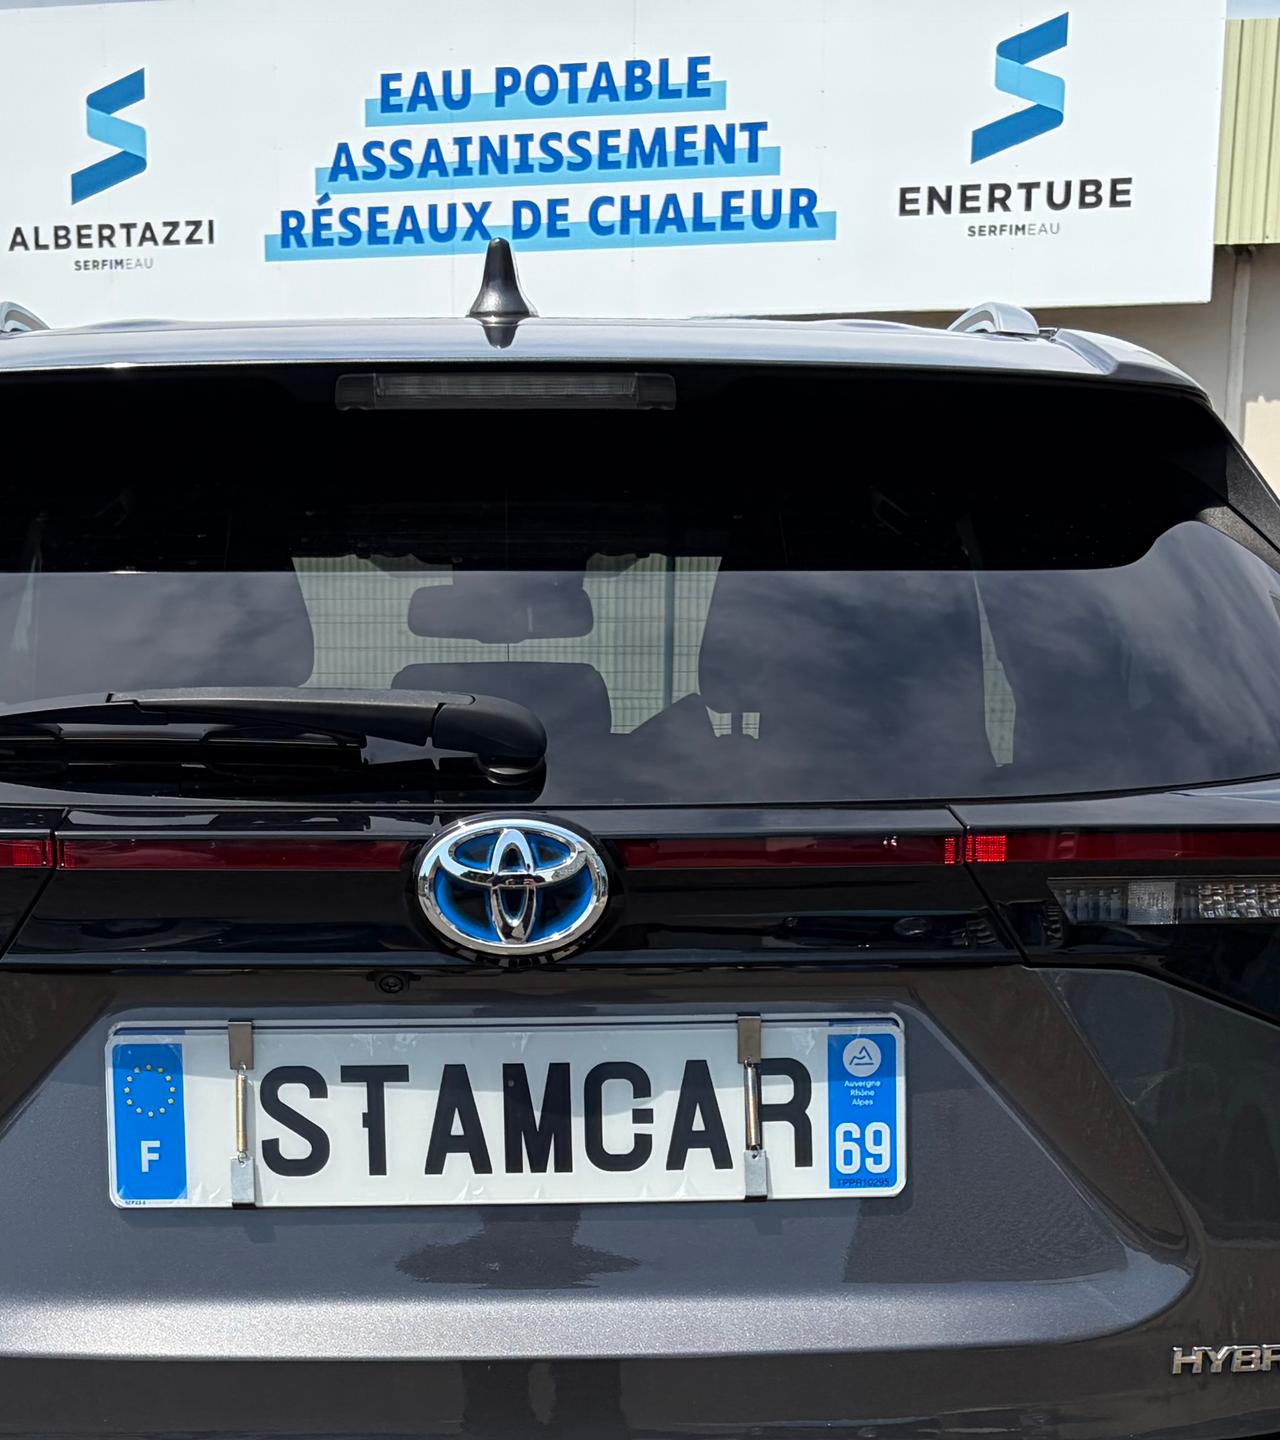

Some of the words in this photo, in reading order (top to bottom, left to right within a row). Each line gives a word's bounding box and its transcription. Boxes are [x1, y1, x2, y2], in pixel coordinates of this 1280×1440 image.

[380, 69, 472, 114] EAU
[494, 56, 711, 109] POTABLE
[328, 121, 768, 183] ASSAINISSEMENT
[280, 191, 493, 249] RÉSEAUX
[511, 197, 571, 240] DE
[588, 187, 819, 237] CHALEUR
[898, 176, 1133, 217] ENERTUBE
[8, 219, 216, 253] ALBERTAZZI
[260, 1056, 814, 1178] STAMCAR
[140, 1140, 161, 1173] F
[835, 1121, 891, 1175] 69
